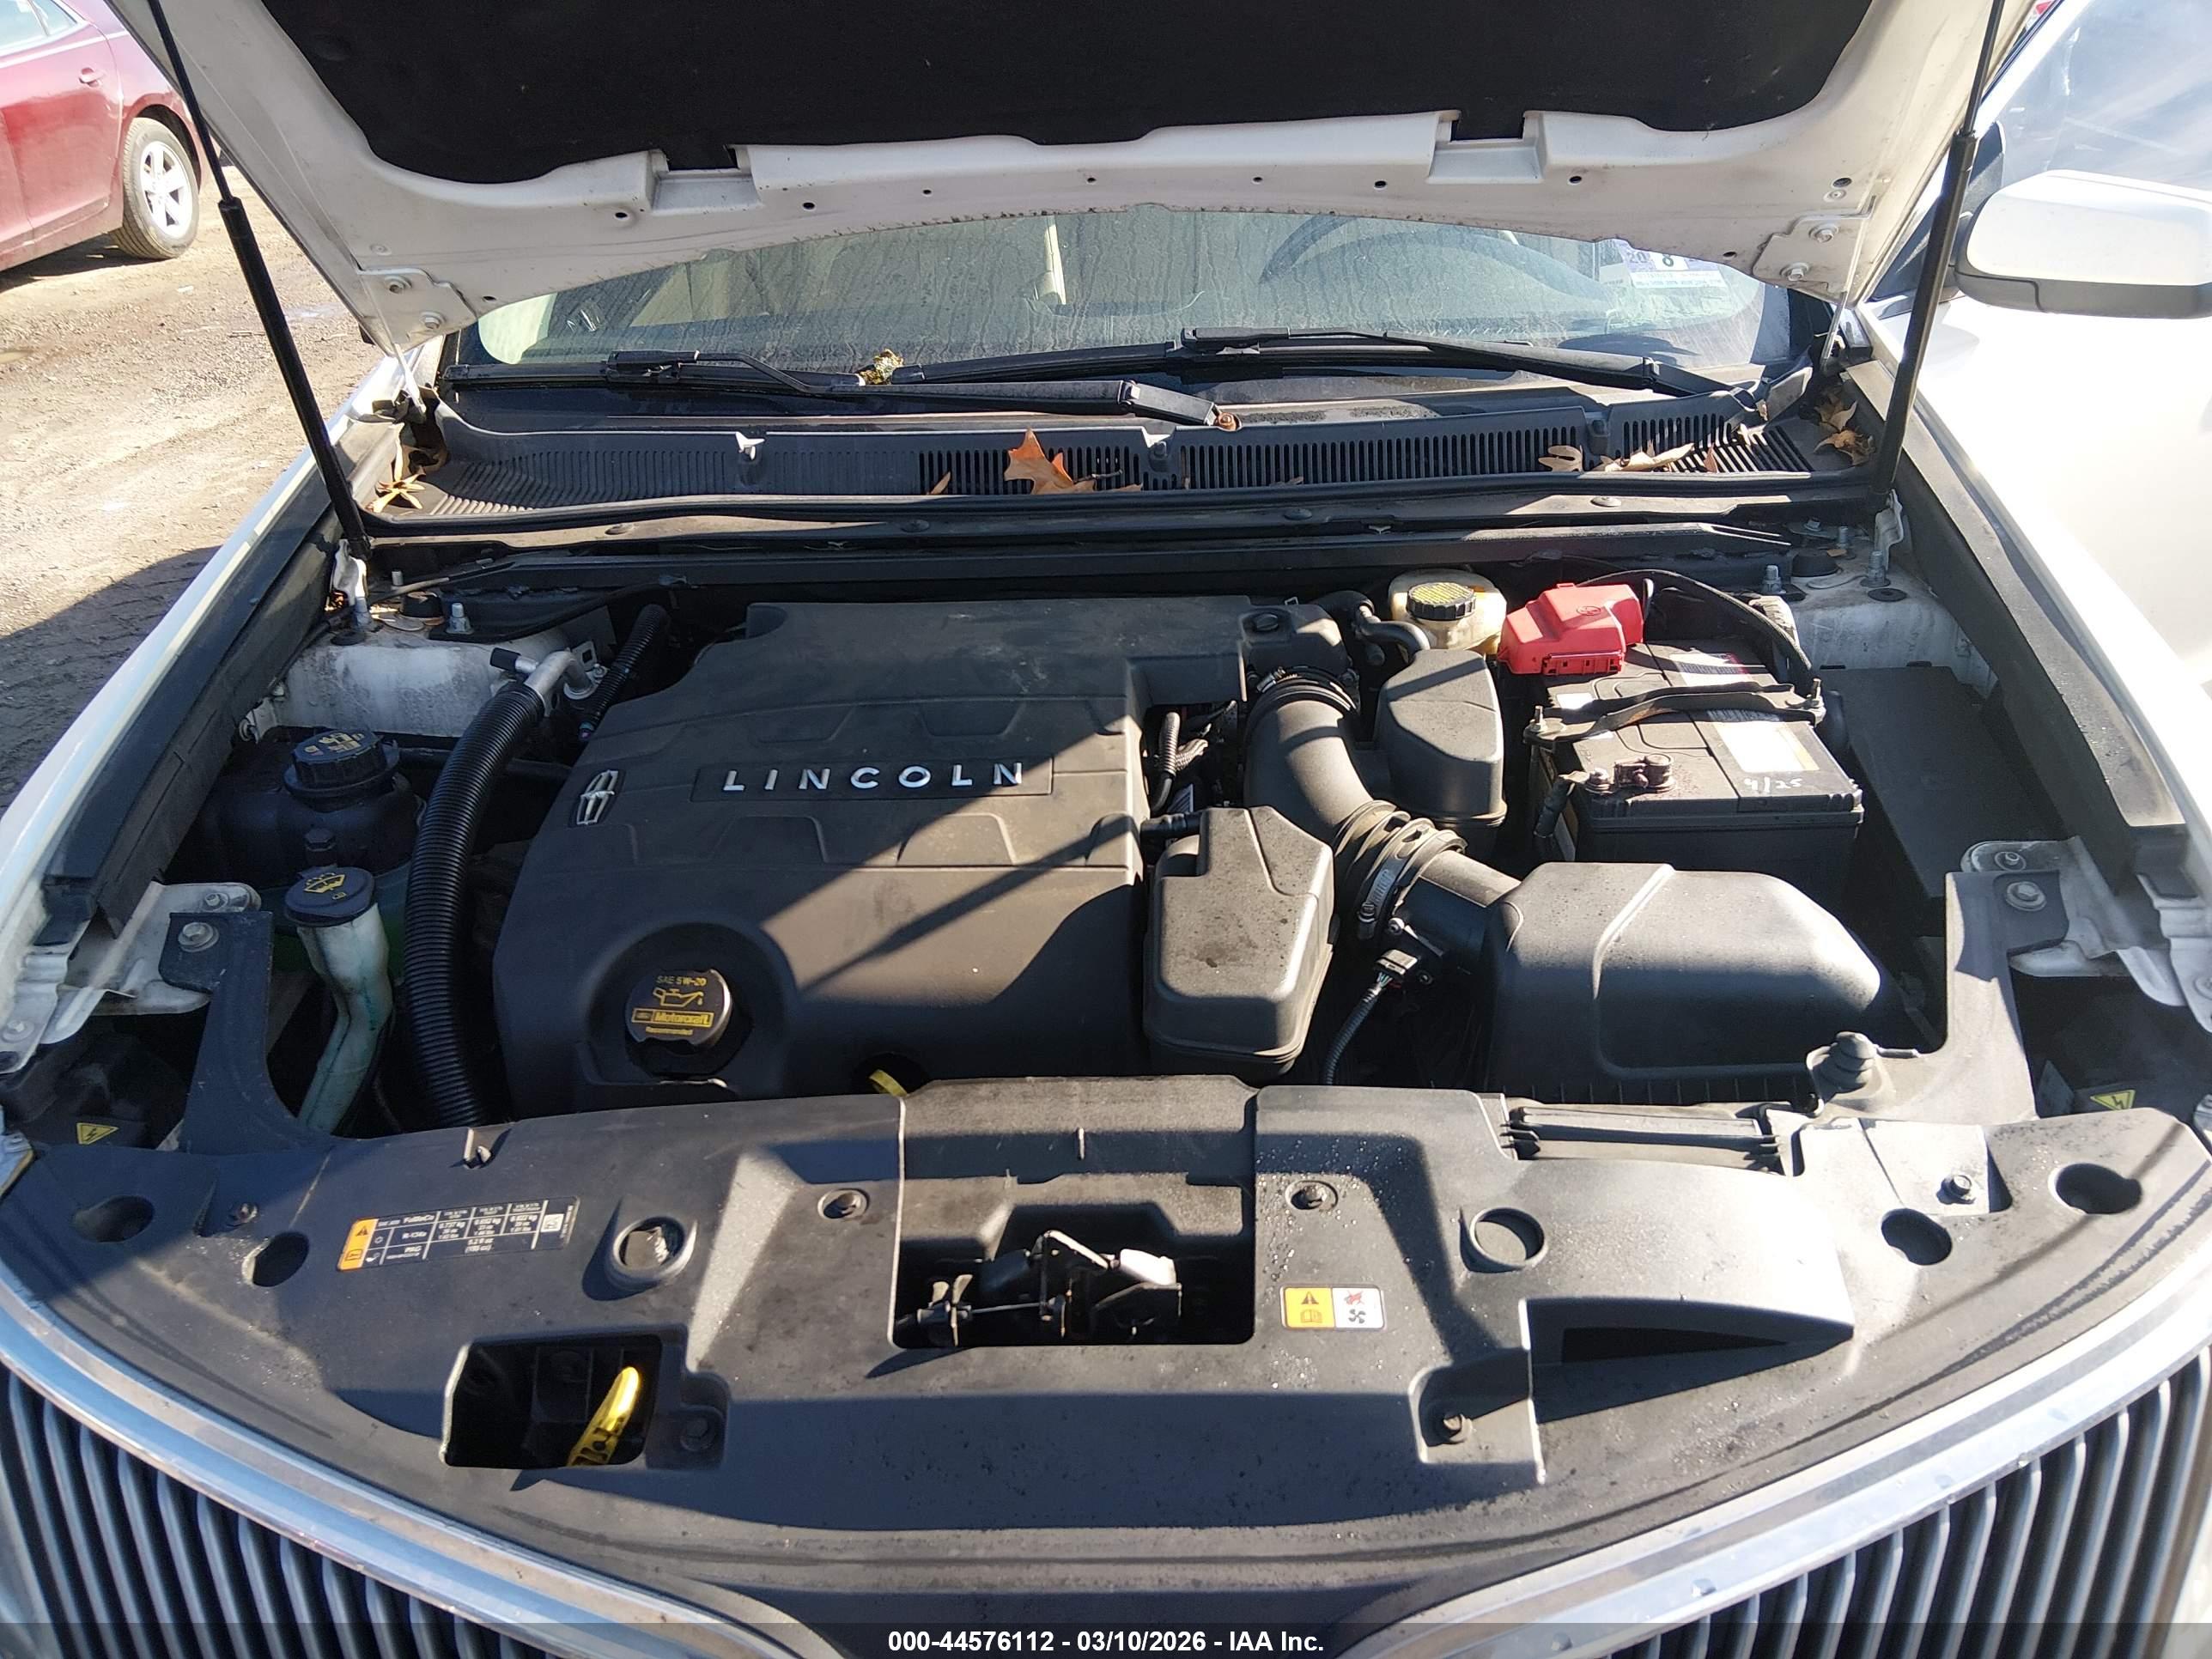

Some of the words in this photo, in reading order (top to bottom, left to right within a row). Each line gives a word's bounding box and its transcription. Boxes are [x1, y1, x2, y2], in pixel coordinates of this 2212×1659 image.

[722, 762, 1023, 792] LINCOLN
[657, 975, 675, 985] SAE
[677, 977, 708, 986] 5W-20
[655, 1012, 711, 1024] Motorcraft
